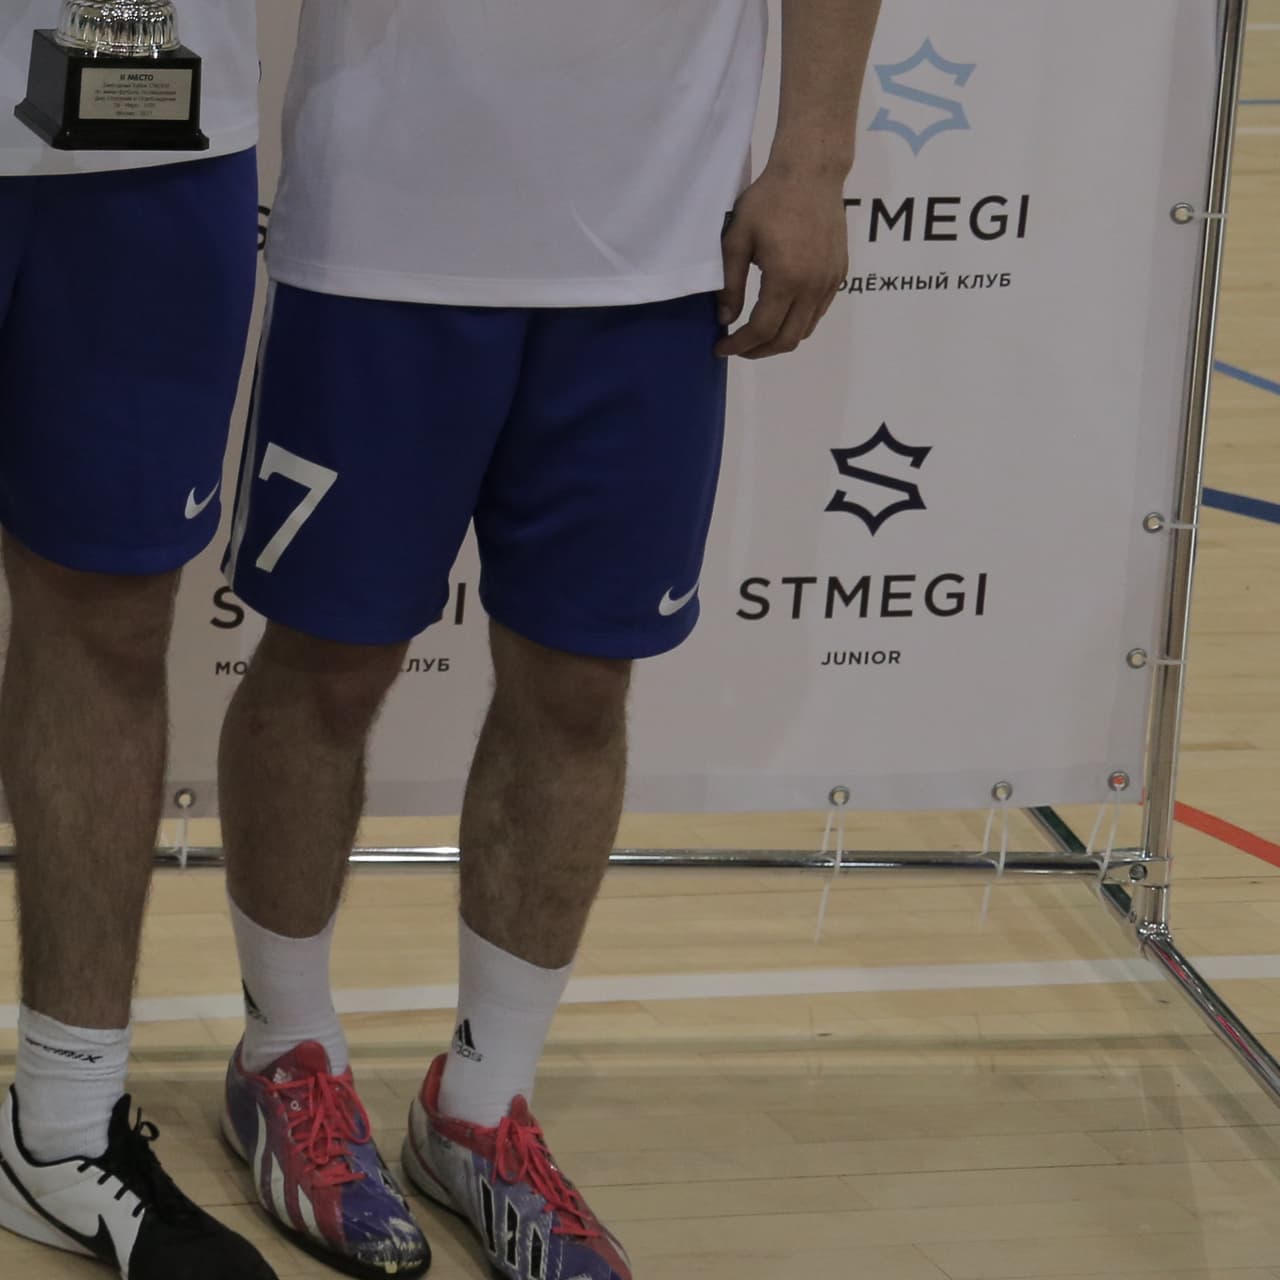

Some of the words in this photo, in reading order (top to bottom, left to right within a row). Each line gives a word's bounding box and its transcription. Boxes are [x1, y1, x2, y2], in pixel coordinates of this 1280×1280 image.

[844, 194, 1030, 243] MEGI
[957, 272, 1011, 290] КЛУБ
[258, 441, 338, 573] 7
[735, 572, 988, 621] STMEGI
[403, 657, 450, 673] ЛУБ
[820, 650, 901, 666] JUNIOR
